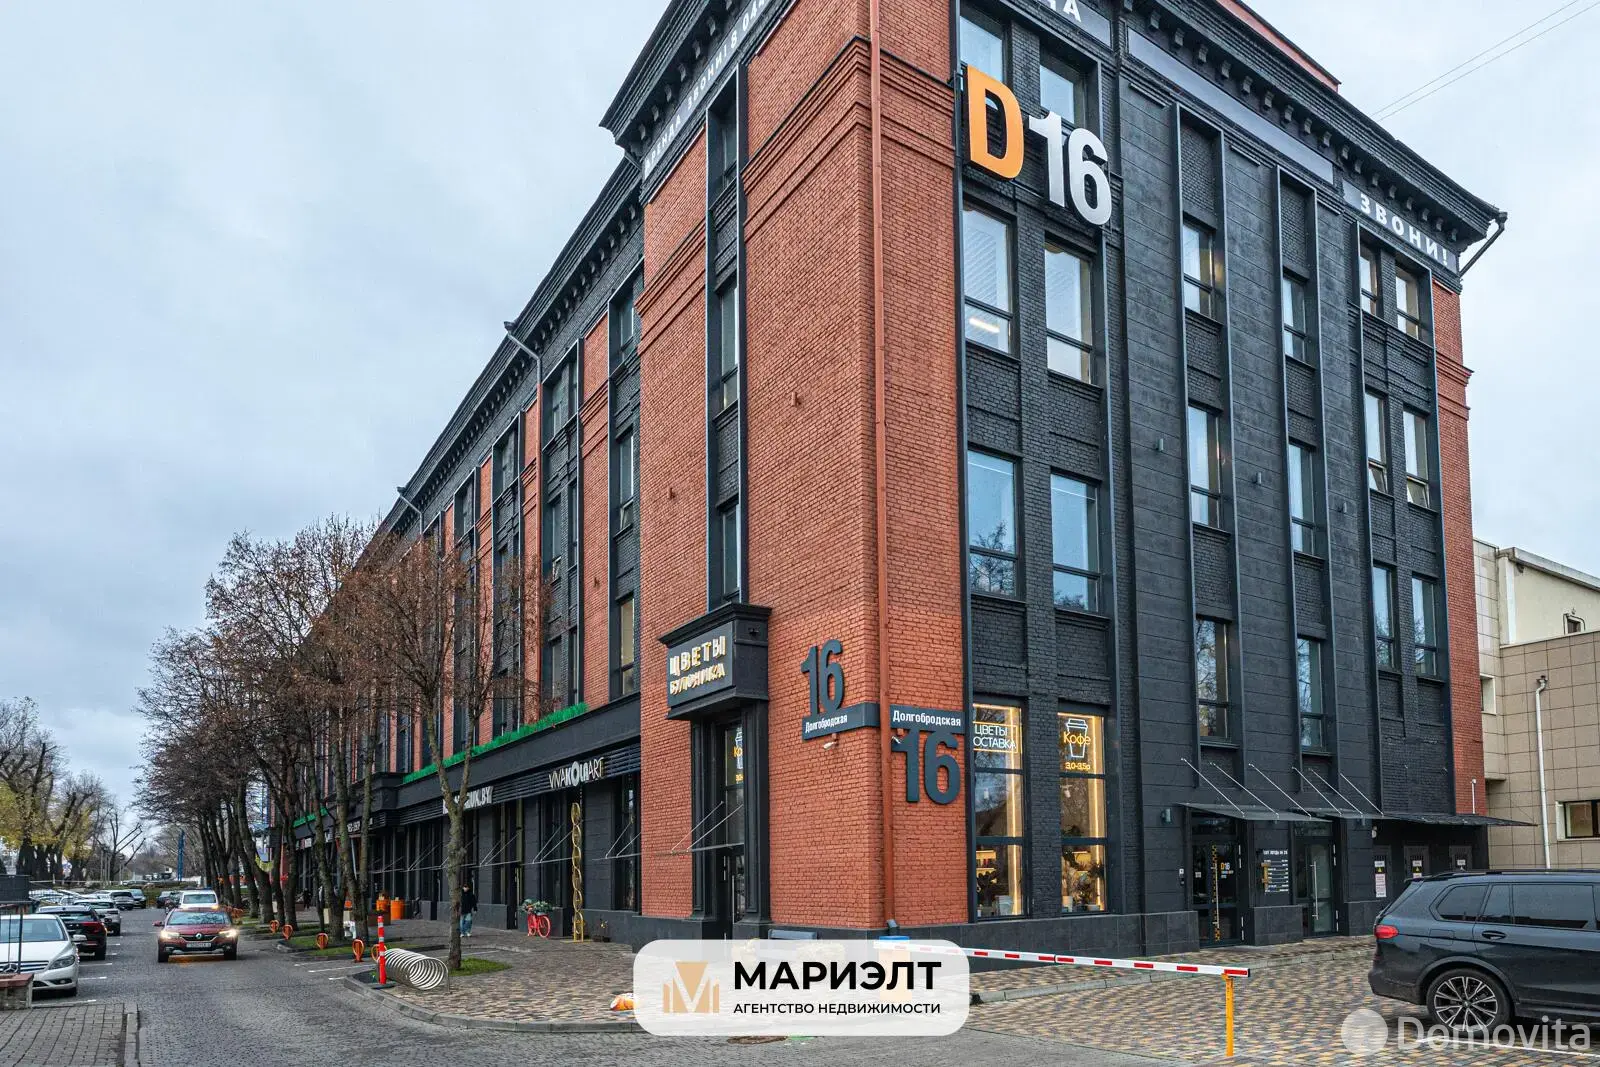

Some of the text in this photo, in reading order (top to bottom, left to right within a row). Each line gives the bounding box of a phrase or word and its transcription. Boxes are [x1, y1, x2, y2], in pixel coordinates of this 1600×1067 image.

[1360, 192, 1448, 265] ЗВОНИ!
[670, 635, 726, 676] ЦВЕТЫ
[801, 639, 845, 715] 16
[805, 714, 848, 734] Долгобродская
[892, 710, 961, 727] Долгобродская
[974, 724, 1008, 736] ЦВЕТЫ
[1063, 731, 1091, 747] Кофе
[973, 737, 1017, 749] ОСТАВКА
[891, 729, 961, 805] 16
